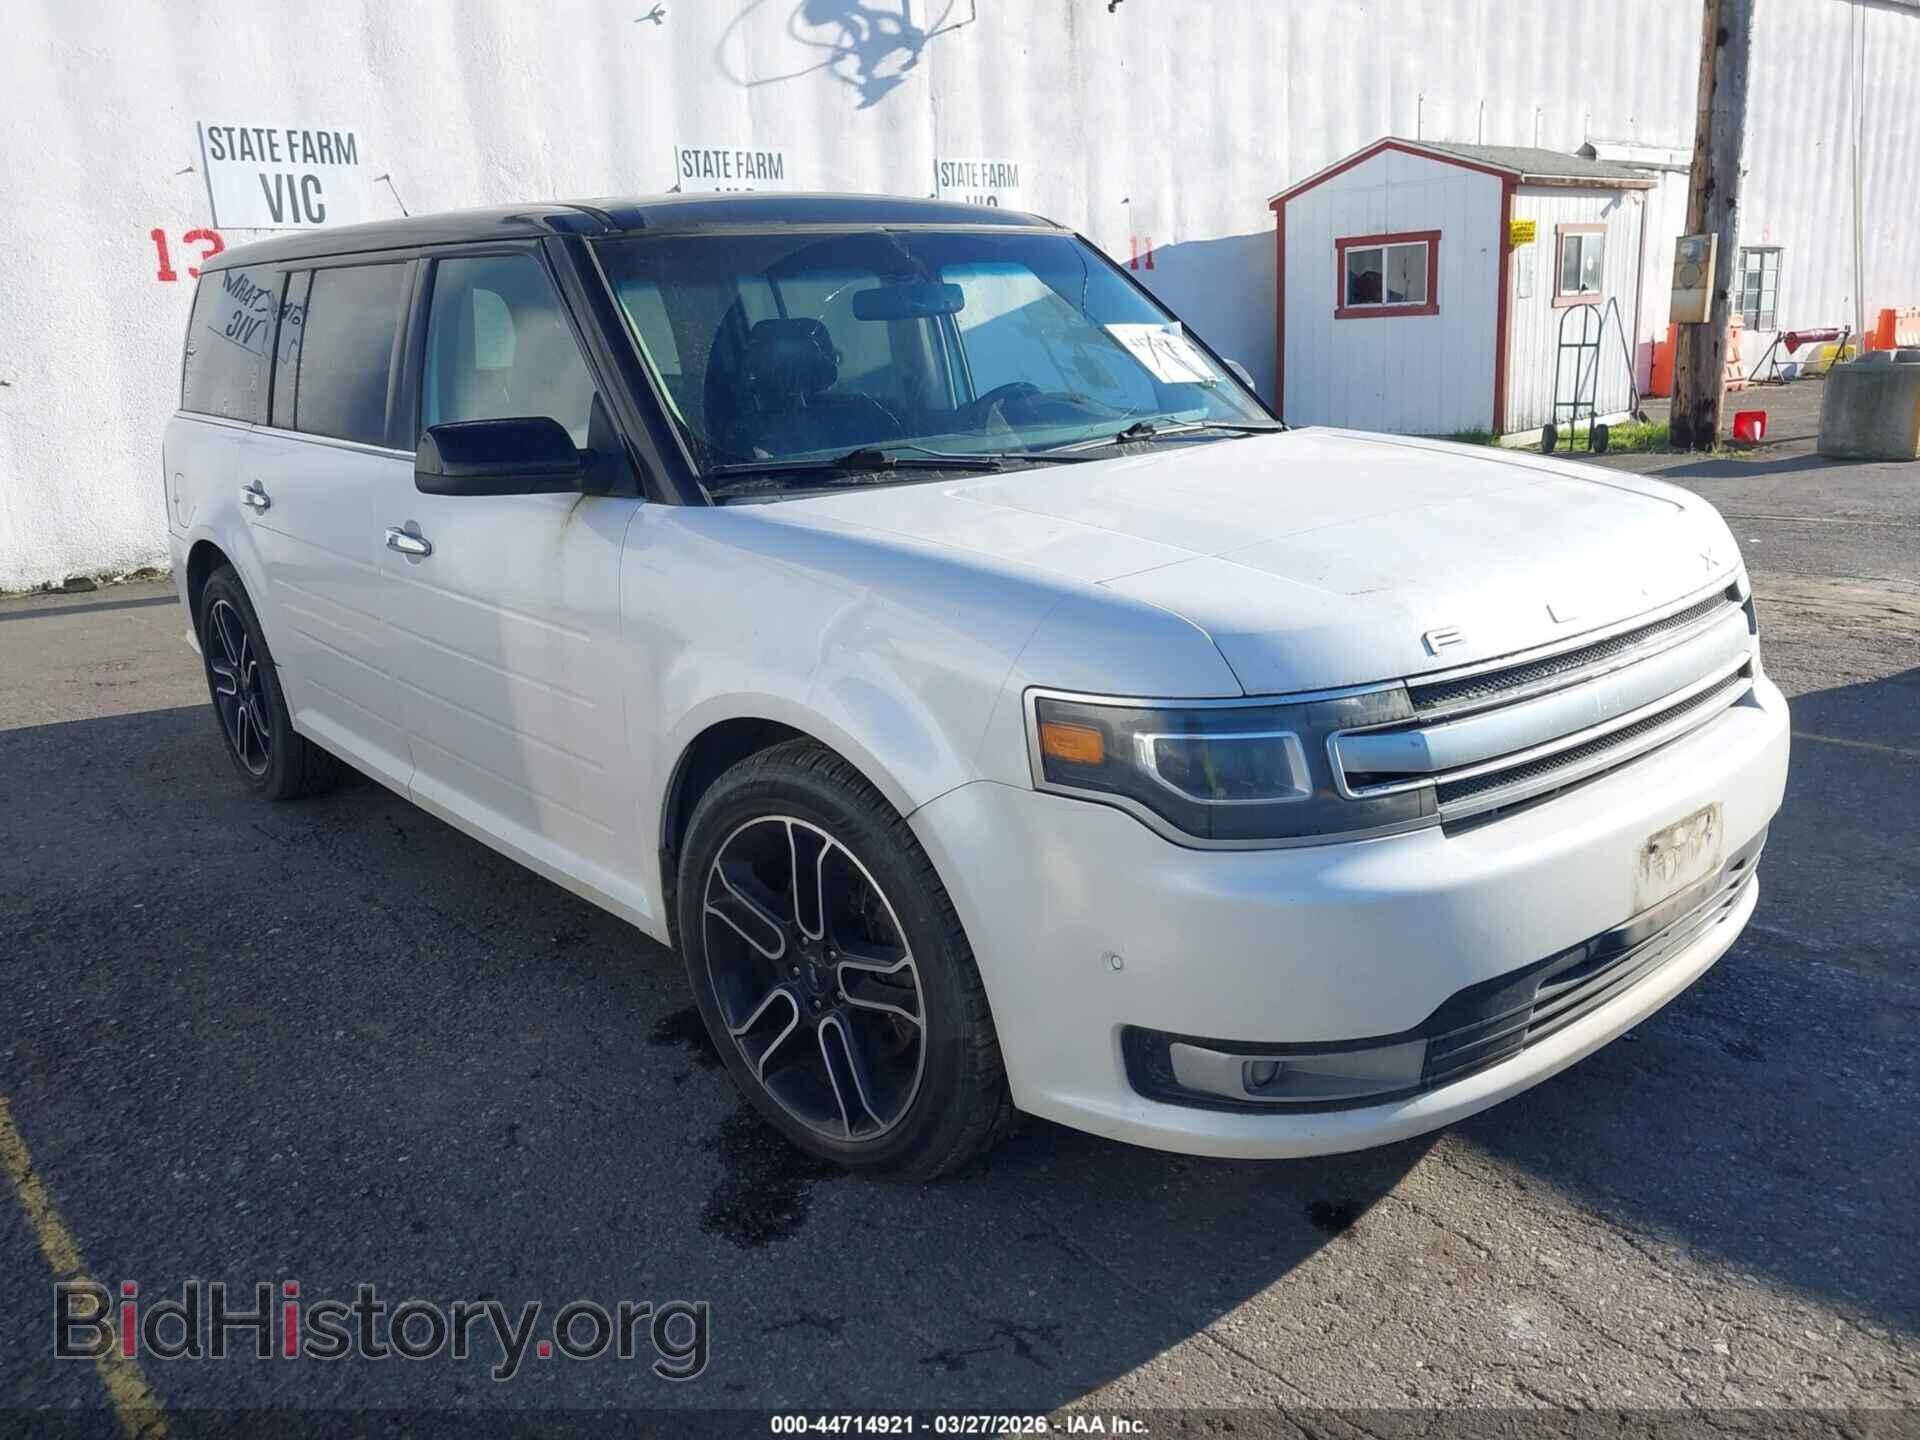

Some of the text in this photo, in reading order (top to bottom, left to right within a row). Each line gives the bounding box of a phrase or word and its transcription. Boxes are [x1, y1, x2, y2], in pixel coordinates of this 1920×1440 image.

[208, 126, 359, 166] STATE FARM
[682, 149, 784, 180] STATE FARM
[941, 162, 1019, 188] STATE FARM
[258, 173, 326, 224] VIC
